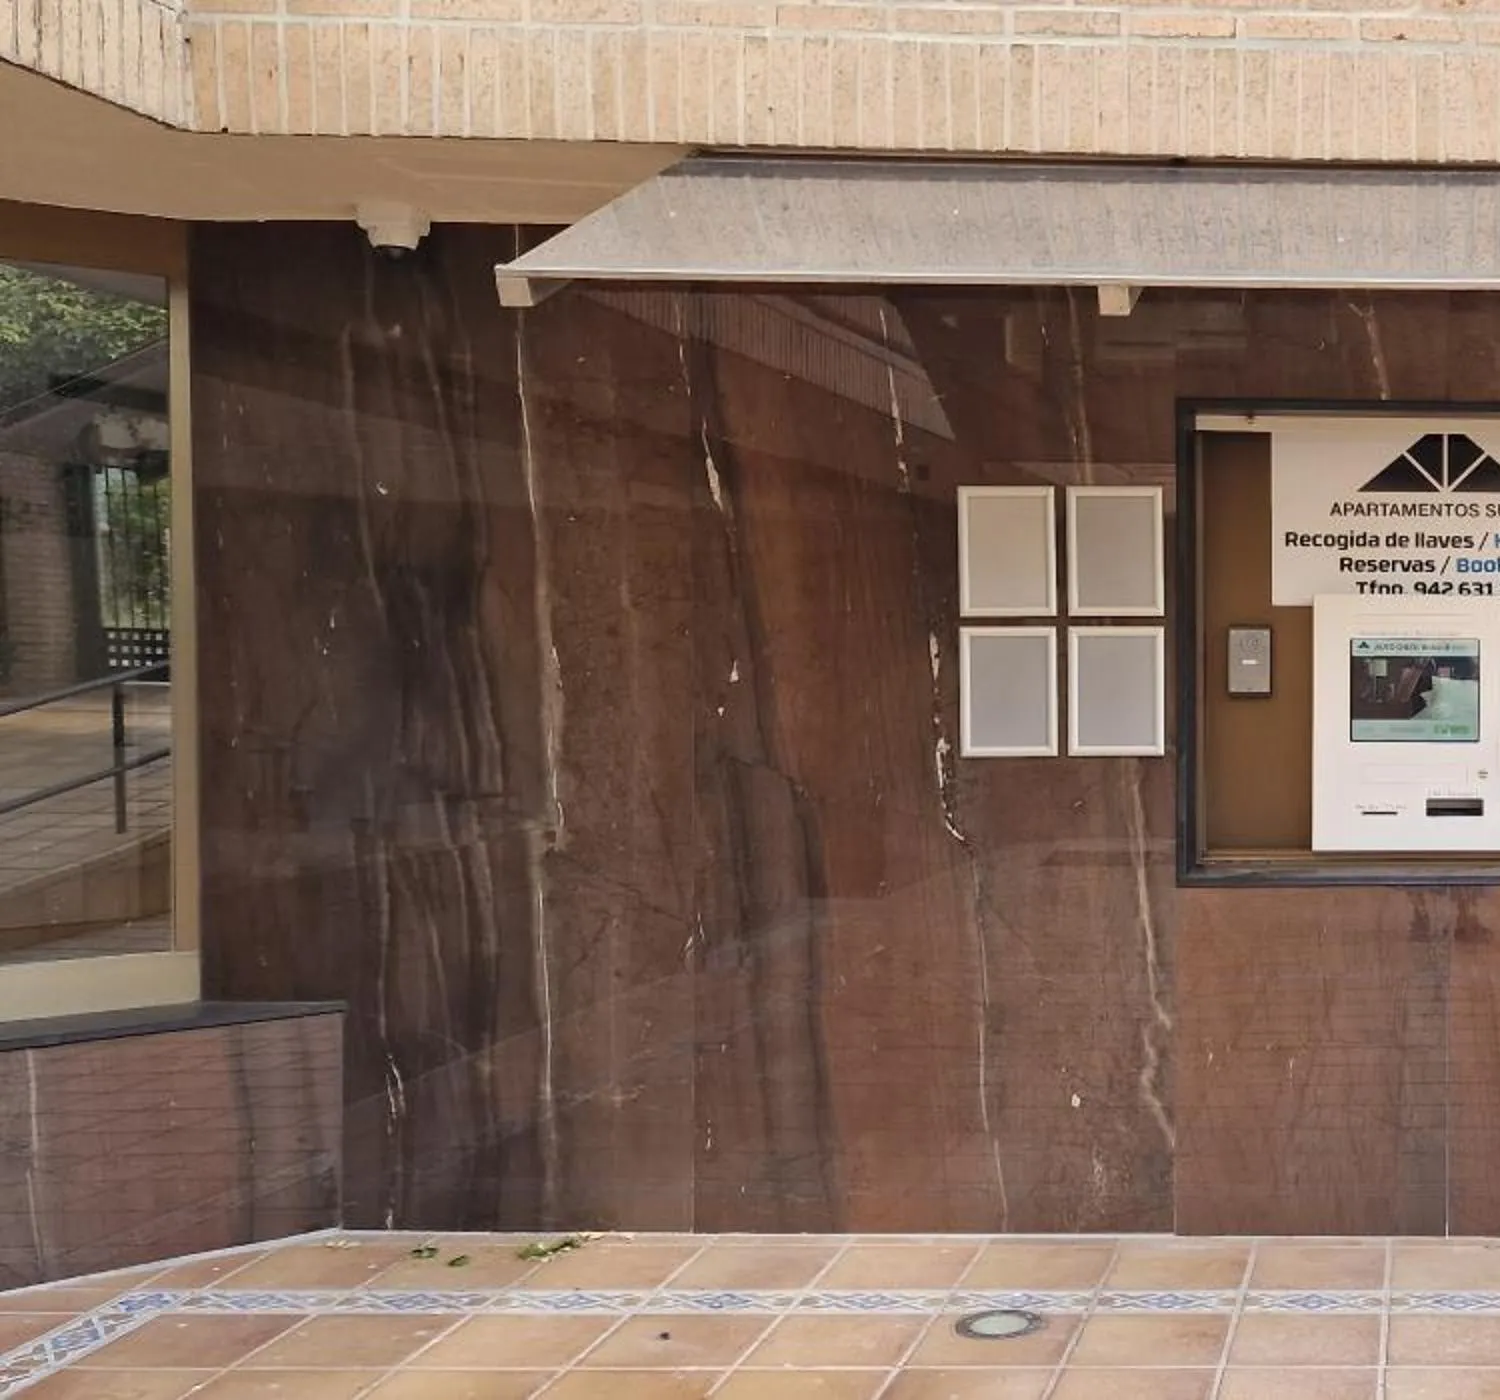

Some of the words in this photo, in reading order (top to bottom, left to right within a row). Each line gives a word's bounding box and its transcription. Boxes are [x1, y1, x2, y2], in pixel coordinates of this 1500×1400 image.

[1329, 503, 1479, 518] APARTAMENTOS
[1284, 531, 1380, 550] Recogida
[1385, 531, 1410, 548] de
[1415, 532, 1475, 549] llaves
[1478, 532, 1489, 551] /
[1339, 557, 1435, 574] Reservas
[1440, 556, 1451, 575] /
[1355, 580, 1408, 596] Tfno
[1413, 581, 1454, 597] 942
[1458, 582, 1494, 597] 631
